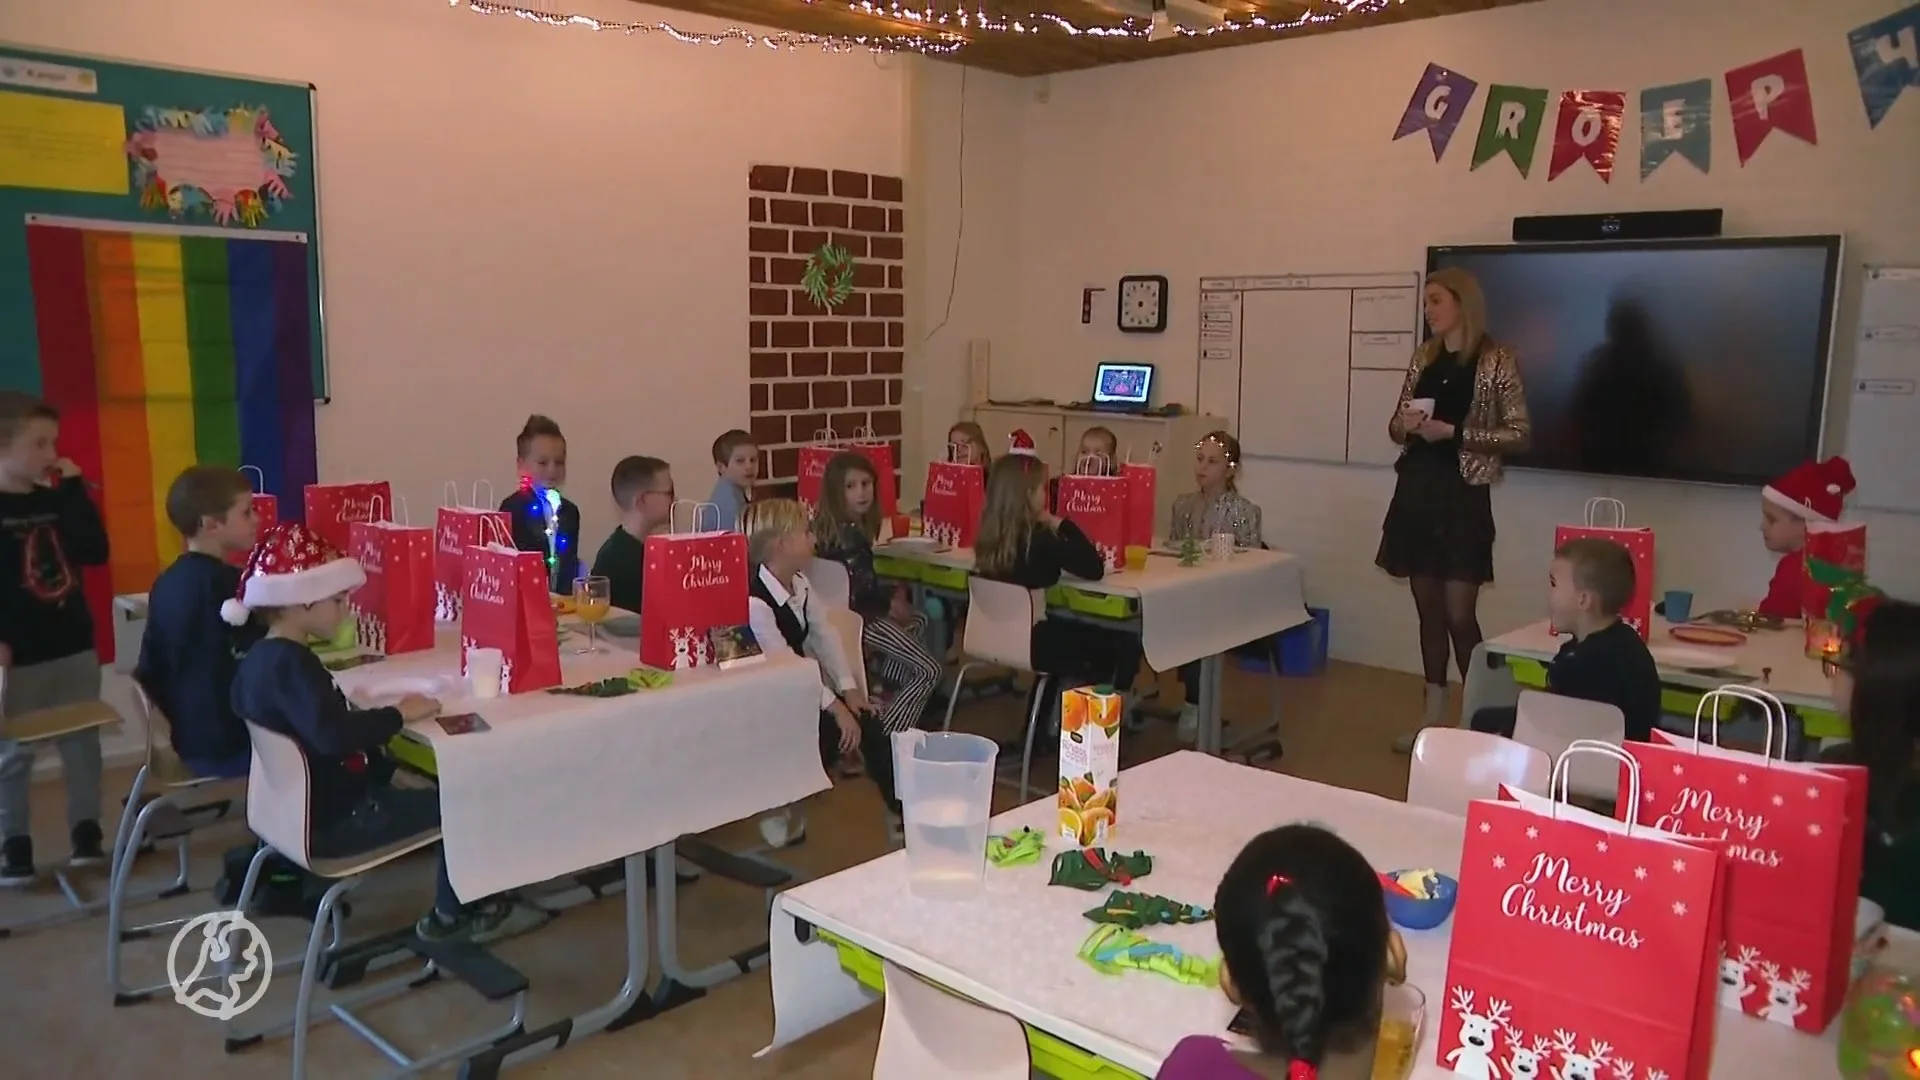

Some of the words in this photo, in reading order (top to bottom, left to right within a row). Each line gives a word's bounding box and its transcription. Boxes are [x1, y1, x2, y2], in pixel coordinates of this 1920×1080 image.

[1423, 73, 1786, 147] GROEP
[682, 571, 730, 590] Christmas
[689, 554, 722, 573] Merry
[1670, 786, 1770, 840] Merry
[1653, 814, 1783, 867] Chmas
[1523, 852, 1631, 918] Merry
[1501, 883, 1645, 949] Christmas
